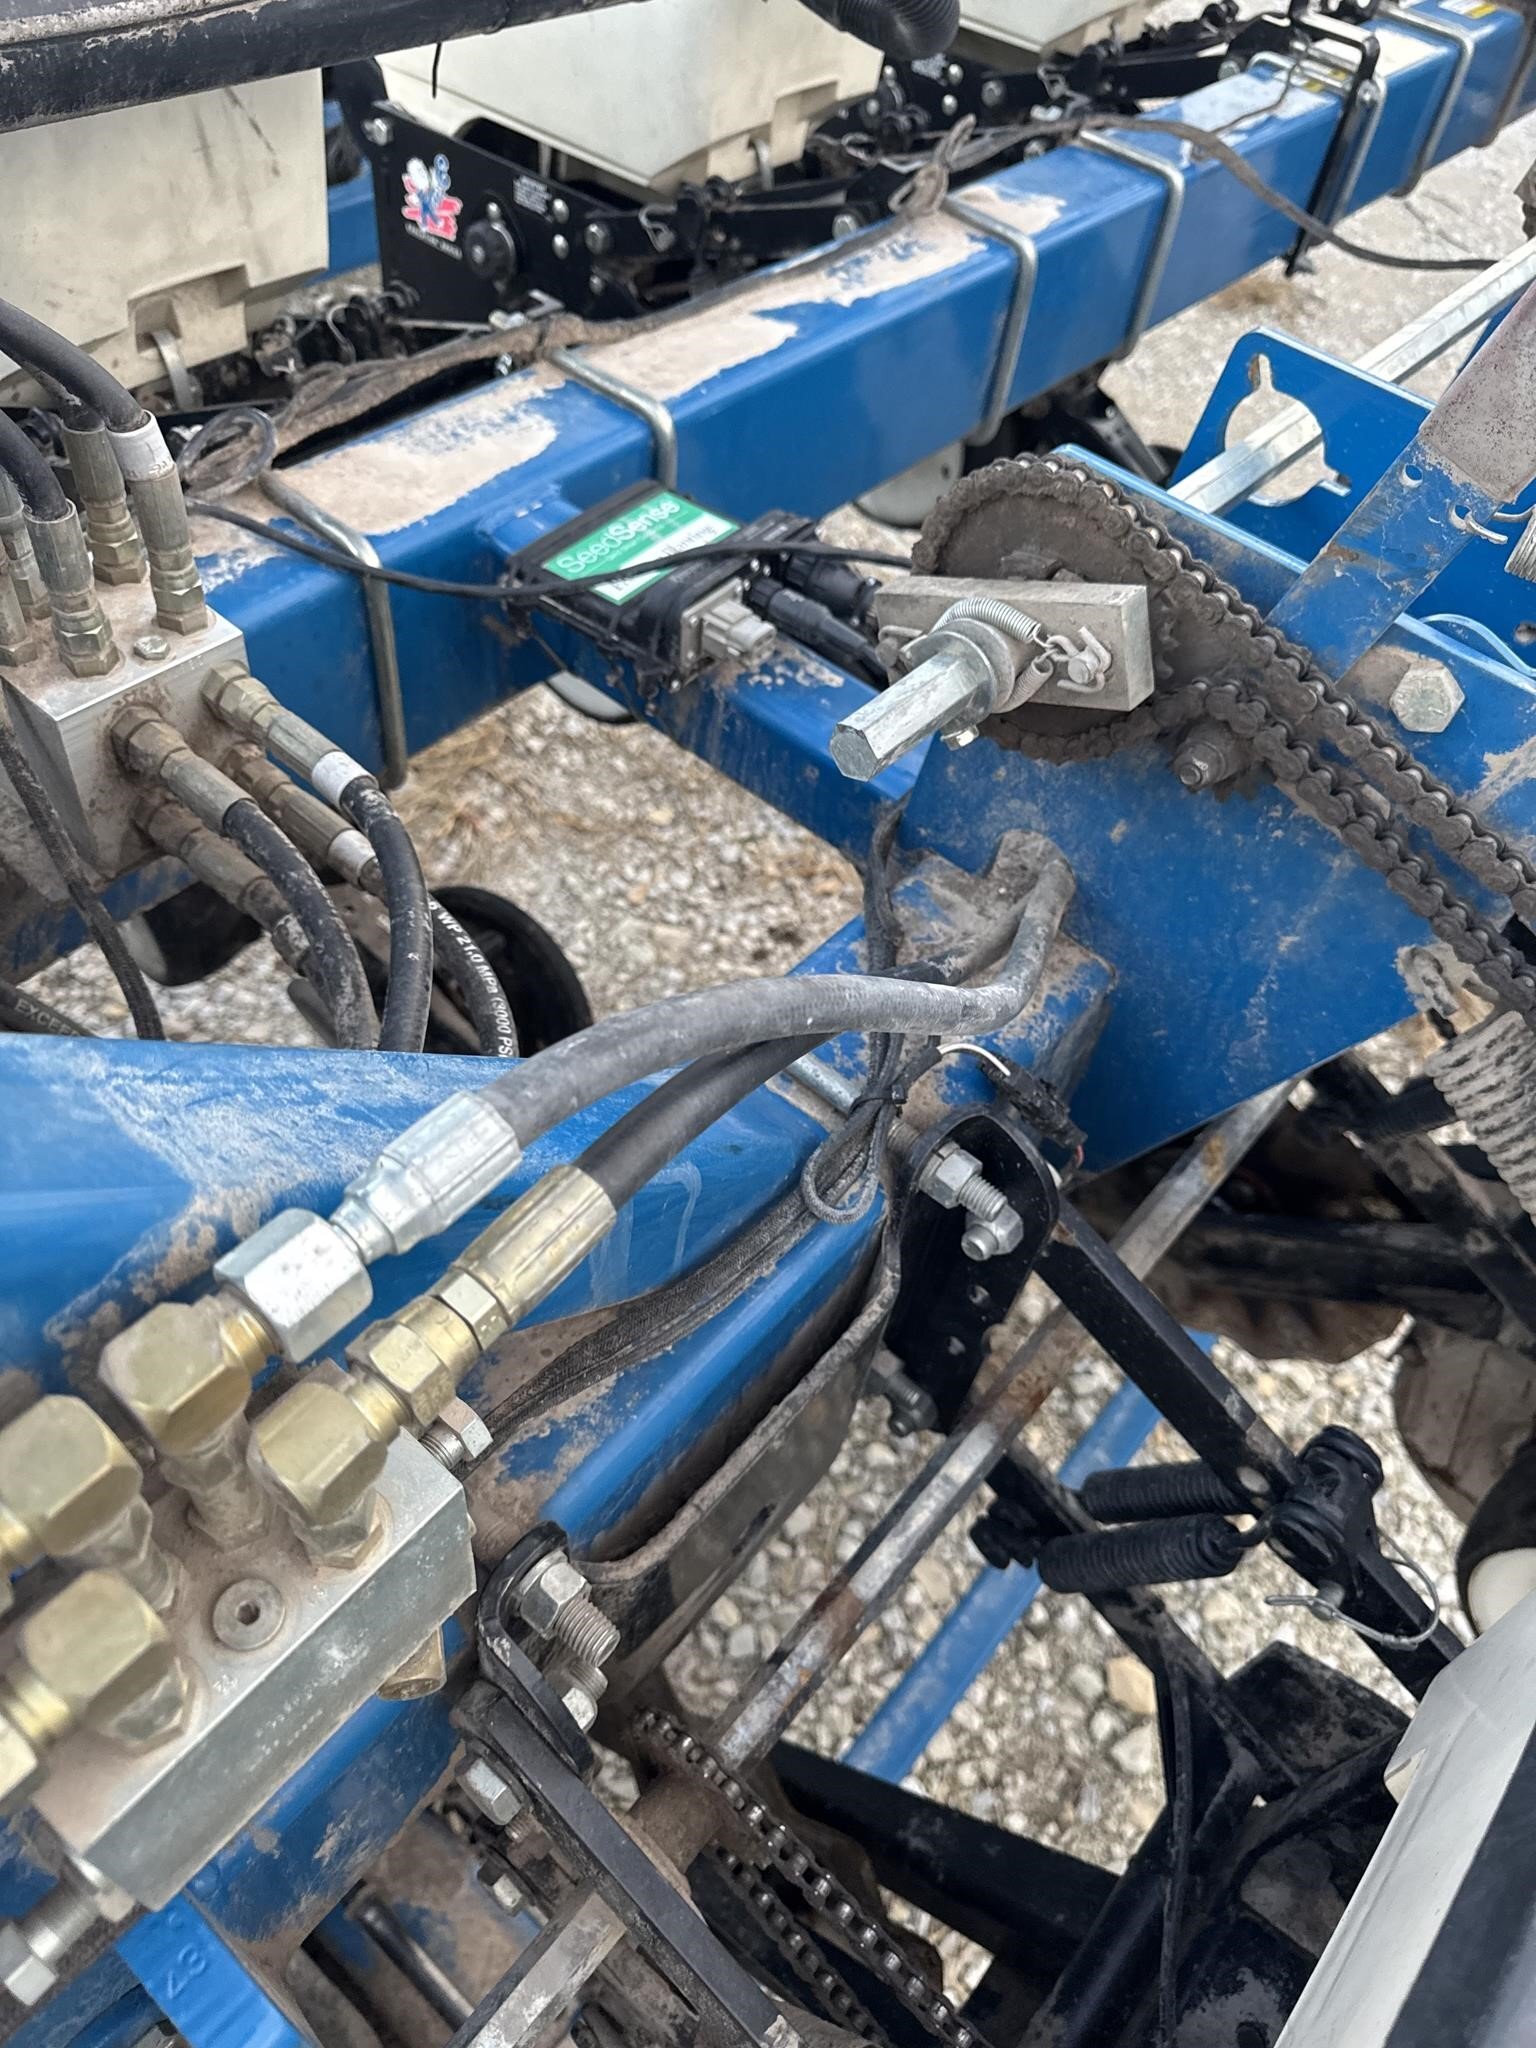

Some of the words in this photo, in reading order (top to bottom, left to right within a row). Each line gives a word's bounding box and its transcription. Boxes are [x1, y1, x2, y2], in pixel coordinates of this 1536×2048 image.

[556, 500, 680, 573] SeedSense
[437, 912, 463, 933] WP
[456, 935, 484, 963] 21.0
[476, 965, 498, 994] MPa
[490, 997, 511, 1034] (3000
